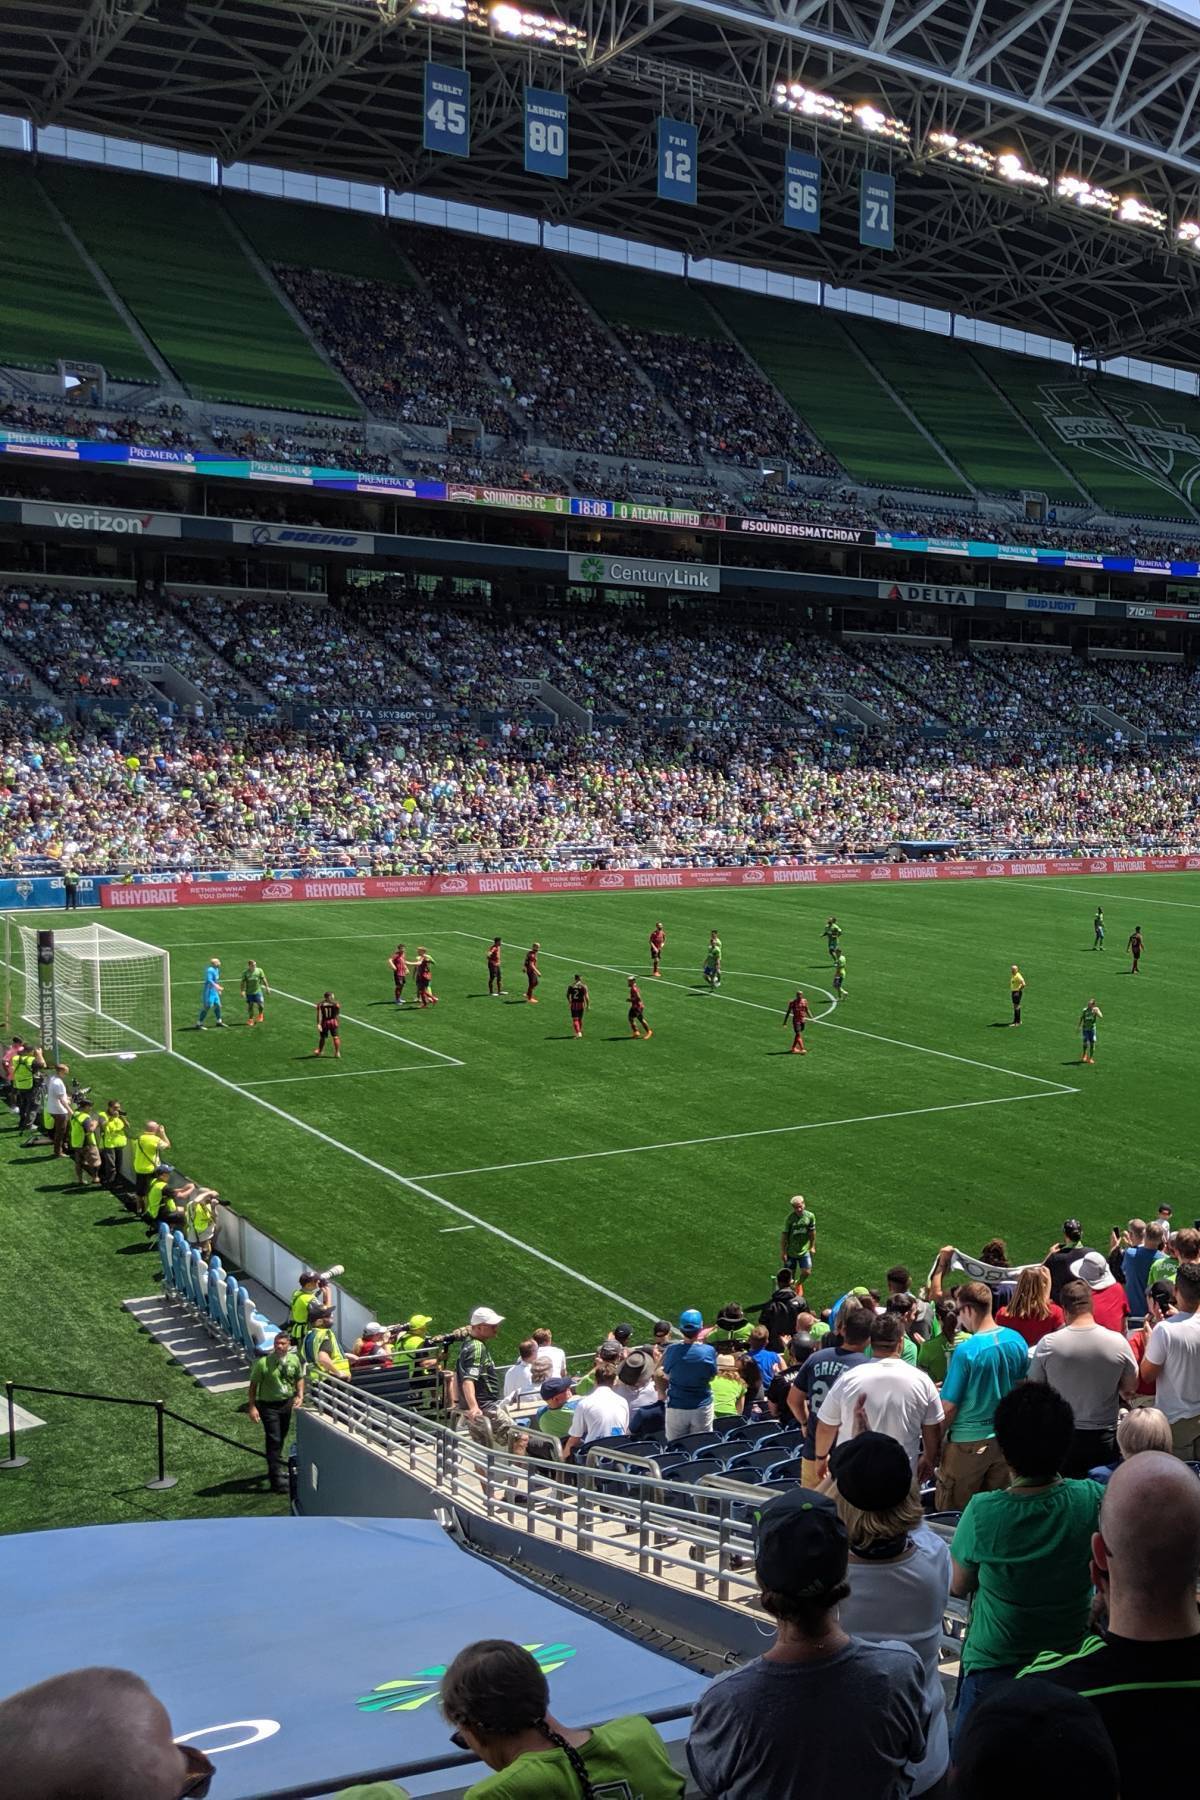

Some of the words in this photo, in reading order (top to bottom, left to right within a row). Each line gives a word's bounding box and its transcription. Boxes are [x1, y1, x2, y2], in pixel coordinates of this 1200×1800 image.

[427, 98, 466, 135] 45
[527, 104, 567, 120] LARGENT
[529, 121, 564, 156] 80
[669, 135, 687, 147] FAN
[664, 150, 691, 183] 12
[788, 181, 817, 214] 96
[865, 201, 889, 232] 71
[7, 432, 62, 448] PREMERA
[129, 446, 180, 461] PREMERA
[250, 460, 297, 475] PREMERA
[358, 473, 402, 487] PREMERA
[483, 490, 532, 509] SOUNDERS
[534, 497, 546, 510] FC
[555, 497, 563, 512] 0
[577, 499, 607, 517] 18:08
[54, 511, 143, 534] verizon
[620, 504, 628, 519] 0
[631, 505, 668, 523] ATLANTA
[669, 509, 700, 526] UNITED
[741, 519, 861, 542] #SOUNDERSMATCHDAY
[277, 531, 358, 547] BOEING
[1134, 559, 1163, 569] PREMERA
[610, 563, 710, 587] CenturyLink
[908, 587, 968, 604] DELTA
[1027, 599, 1047, 609] BUD
[1049, 600, 1077, 612] LIGHT
[1128, 607, 1145, 616] 710
[898, 866, 938, 878] REHYDRATE
[1011, 863, 1048, 875] REHYDRATE
[1113, 861, 1146, 872] REHYDRATE
[634, 873, 682, 887] REHYDRATE
[773, 870, 817, 882] REHYDRATE
[305, 882, 366, 897] REHYDRATE
[479, 877, 533, 892] REHYDRATE
[111, 889, 177, 904] REHYDRATE
[42, 981, 53, 996] FC
[573, 990, 580, 1000] 2
[43, 997, 54, 1051] SOUNDERS
